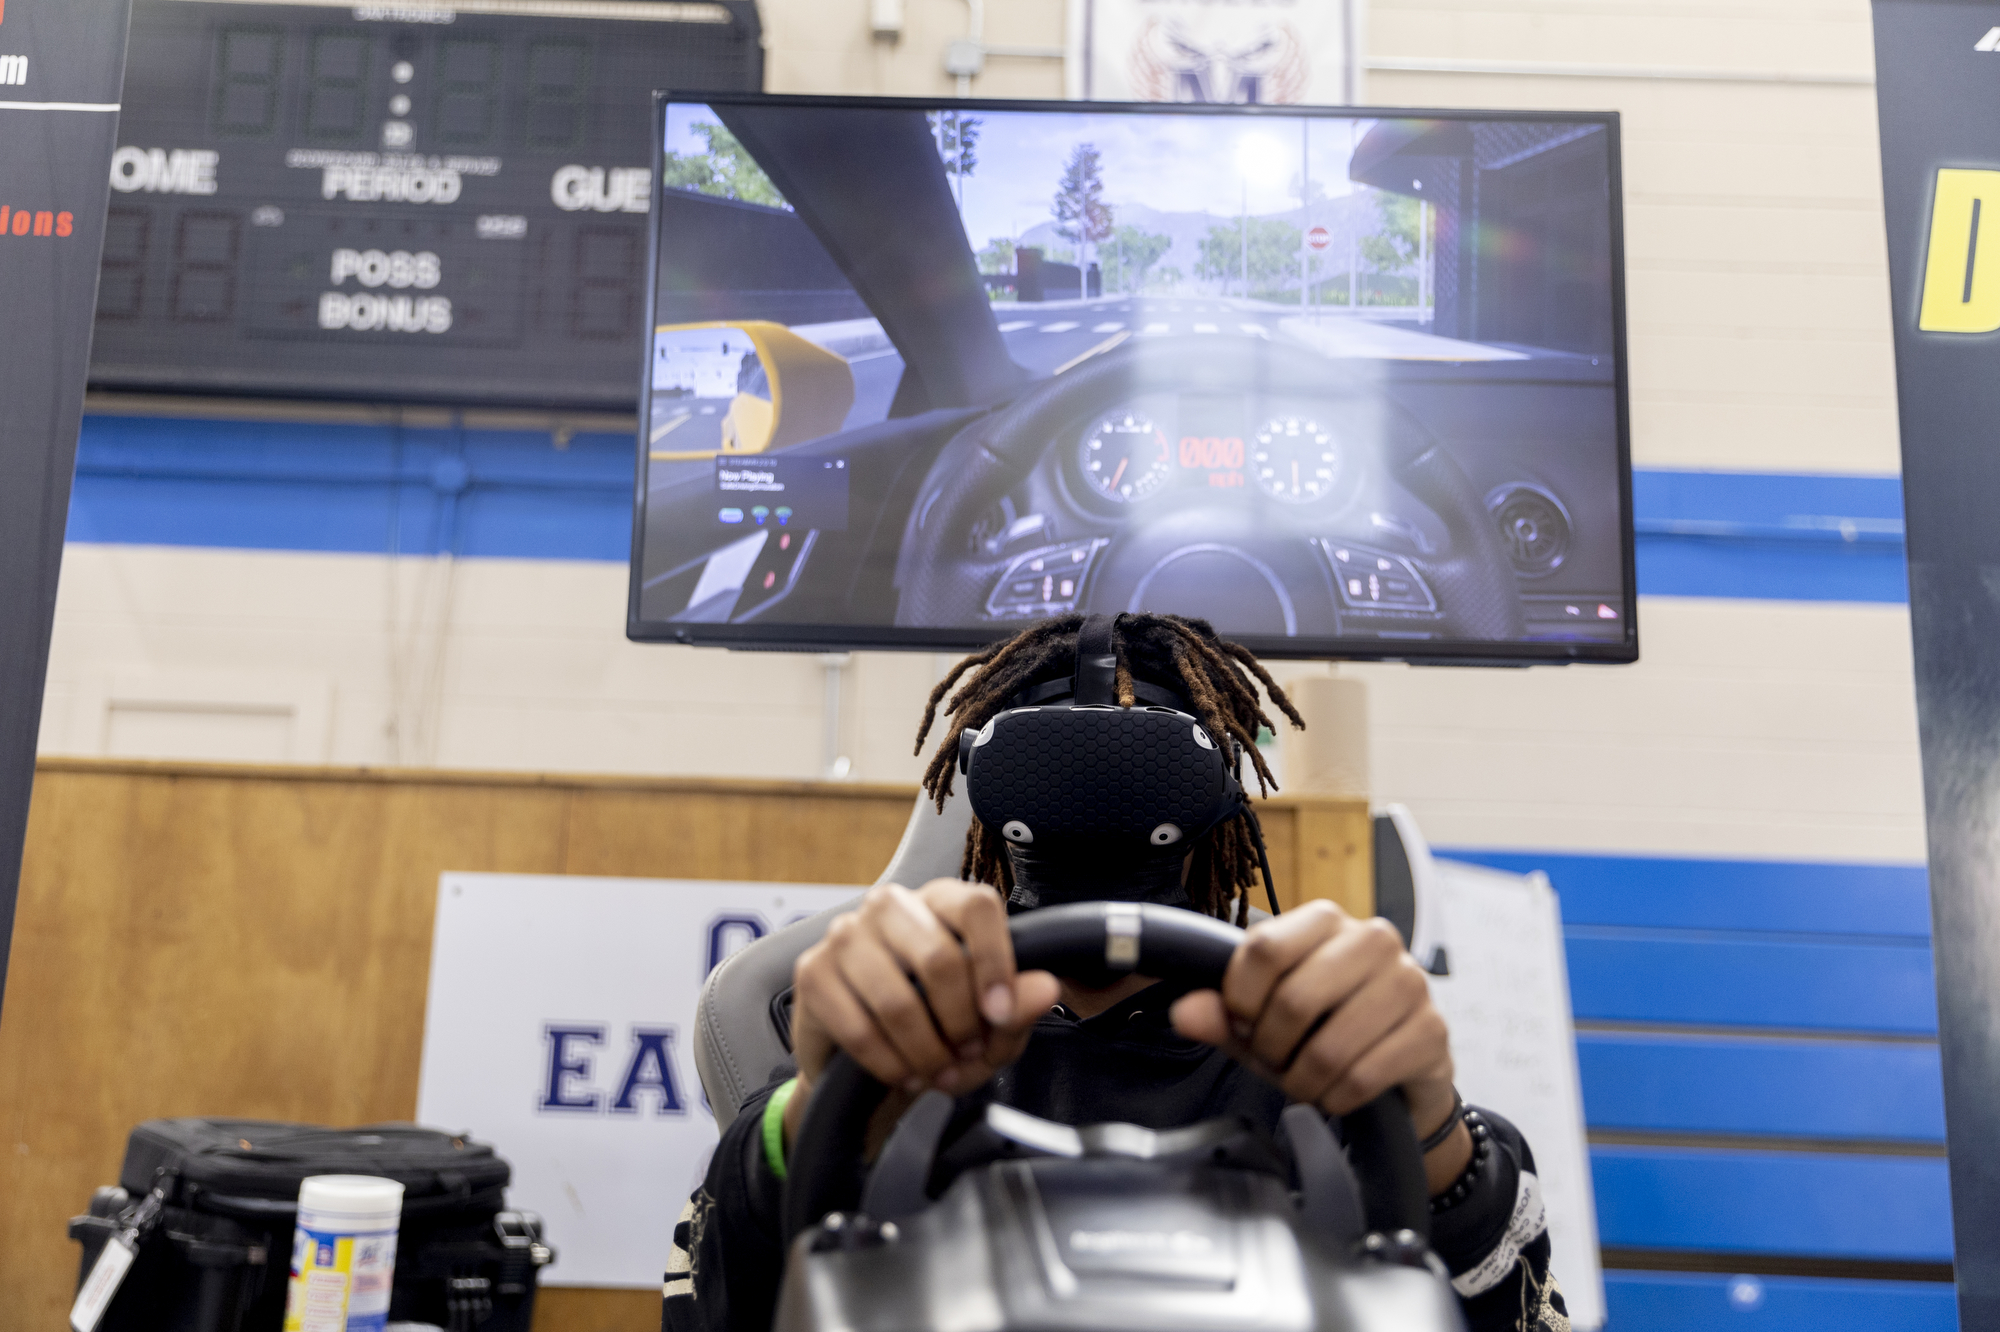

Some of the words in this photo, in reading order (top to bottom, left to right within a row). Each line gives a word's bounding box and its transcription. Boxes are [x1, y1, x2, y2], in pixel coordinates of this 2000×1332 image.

[110, 146, 219, 195] OME
[321, 165, 462, 204] PERIOD
[551, 165, 651, 213] GUE
[330, 249, 441, 289] POSS
[318, 291, 453, 334] BONUS
[534, 1018, 713, 1119] EA
